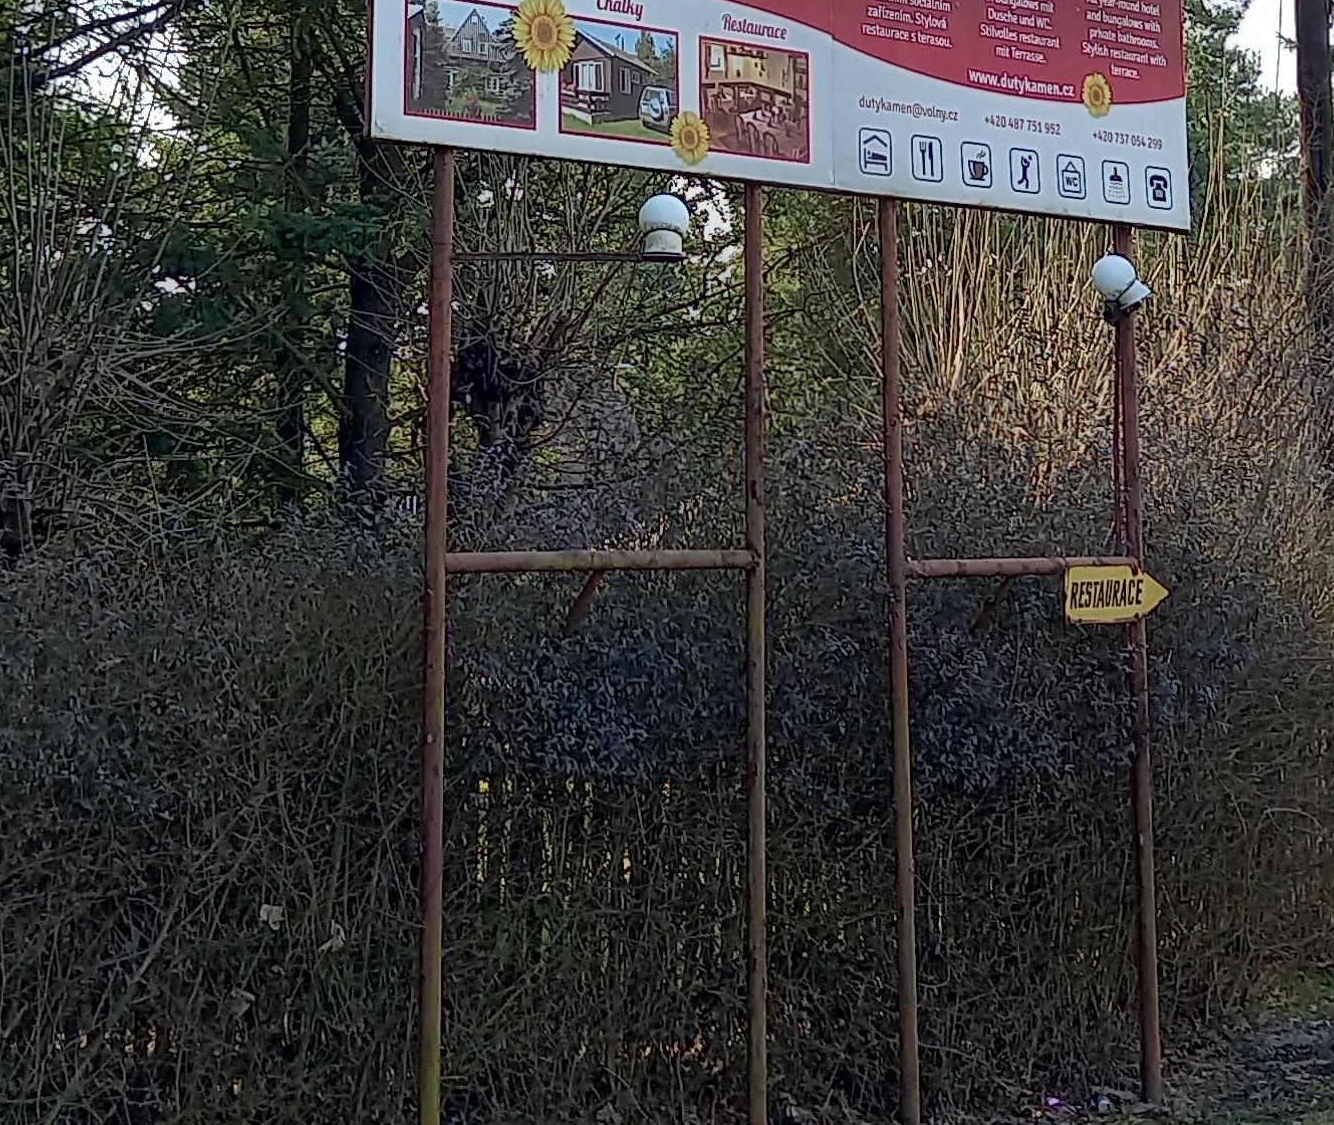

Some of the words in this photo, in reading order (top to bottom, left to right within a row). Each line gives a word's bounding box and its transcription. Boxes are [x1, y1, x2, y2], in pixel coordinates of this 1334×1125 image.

[867, 5, 914, 23] zařízením.
[915, 12, 947, 29] Stylová
[988, 7, 1018, 24] Dusche
[1019, 16, 1035, 27] und
[1036, 19, 1052, 30] WC.
[1040, 1, 1054, 13] mit
[1141, 1, 1160, 16] hotel
[722, 14, 788, 40] Restaurace
[1086, 10, 1101, 22] and
[1102, 11, 1144, 29] bungalows
[1144, 20, 1161, 33] with
[862, 24, 909, 40] restaurace
[911, 33, 917, 42] s
[918, 30, 952, 47] terasou.
[980, 24, 1018, 41] Stilvolles
[1019, 33, 1060, 49] restaurant
[1089, 27, 1116, 41] private
[1117, 31, 1159, 49] bathrooms.
[996, 46, 1010, 57] mit
[1011, 47, 1047, 63] Terrasse.
[1082, 42, 1109, 58] Stylish
[1110, 48, 1149, 64] restaurant
[1150, 55, 1166, 66] with
[968, 69, 1075, 96] www.dutykamen.cz
[1111, 63, 1141, 79] terrace.
[859, 95, 958, 123] dutykamen@volny.cz
[984, 115, 1006, 128] +420
[1008, 117, 1024, 130] 487
[1027, 119, 1042, 133] 751
[1045, 122, 1061, 135] 952
[1092, 130, 1113, 143] +420
[1115, 133, 1129, 145] 737
[1131, 135, 1146, 147] 054
[1147, 137, 1163, 150] 299
[1065, 176, 1079, 187] WC
[1070, 578, 1144, 609] RESTAURACE
